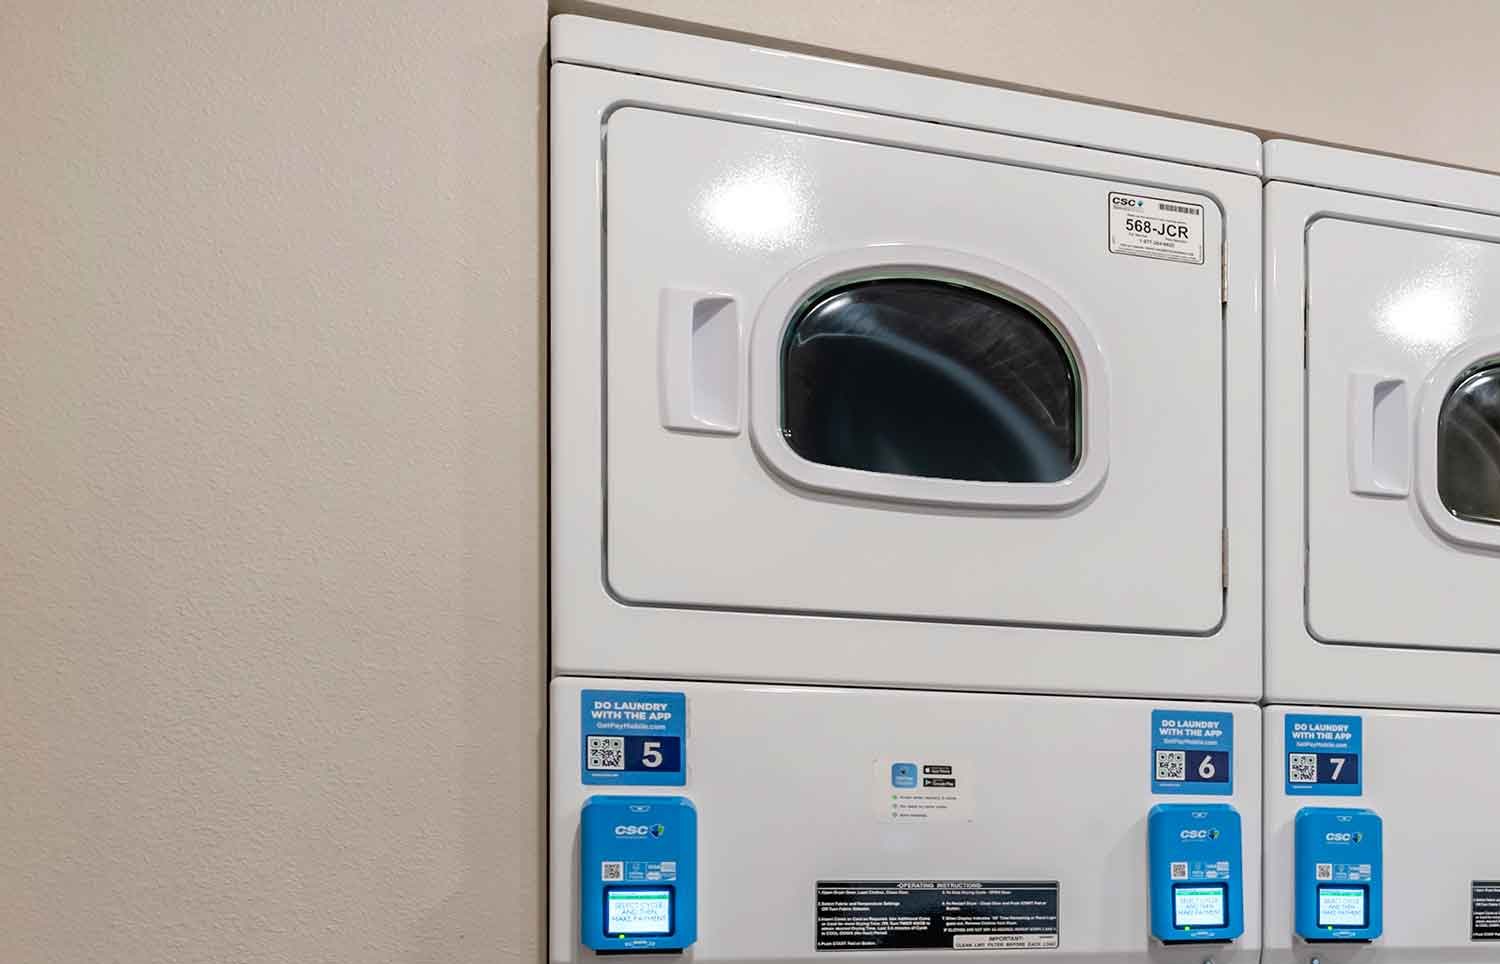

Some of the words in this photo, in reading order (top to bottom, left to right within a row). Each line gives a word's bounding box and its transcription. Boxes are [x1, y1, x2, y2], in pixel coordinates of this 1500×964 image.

[1112, 196, 1136, 207] CSC
[1126, 218, 1189, 239] 568-JCR
[594, 701, 612, 710] DO
[614, 702, 668, 711] LAUNDRY
[592, 710, 622, 720] WITH
[624, 711, 646, 720] THE
[648, 712, 672, 720] APP
[1161, 720, 1176, 728] DO
[1177, 720, 1220, 729] LAUNDRY
[1294, 723, 1308, 731] DO
[1309, 724, 1349, 732] LAUNDRY
[1159, 728, 1184, 736] WITH
[1185, 728, 1203, 736] THE
[1292, 732, 1315, 740] WITH
[1316, 732, 1334, 740] THE
[1334, 732, 1352, 740] APP
[641, 742, 663, 768] 5
[1198, 754, 1216, 779] 6
[1330, 758, 1346, 781] 7
[614, 825, 648, 836] CSC
[1180, 830, 1207, 840] CSC
[1326, 832, 1351, 842] CSC
